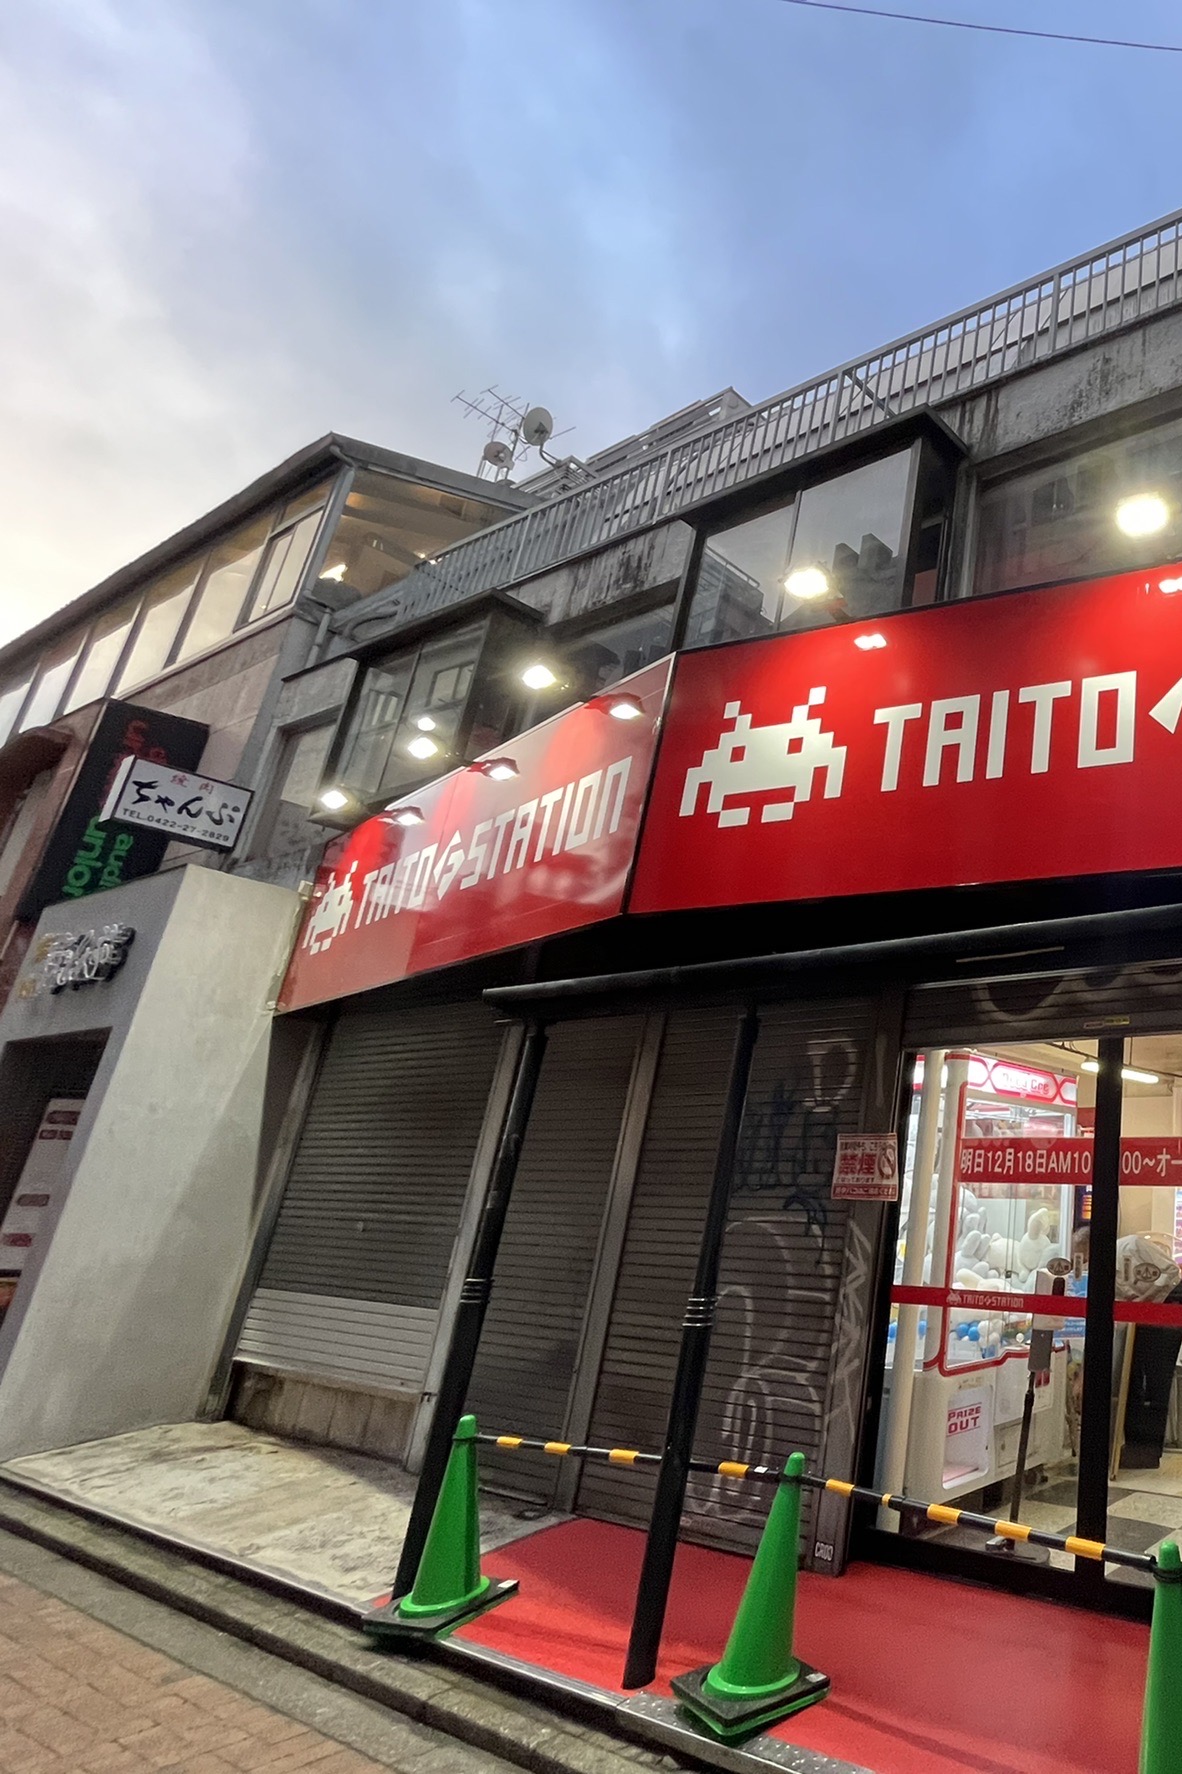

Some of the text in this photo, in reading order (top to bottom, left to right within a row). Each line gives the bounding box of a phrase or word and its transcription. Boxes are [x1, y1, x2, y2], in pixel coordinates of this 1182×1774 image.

[873, 670, 1138, 793] TAITO
[354, 842, 439, 930] TAITO
[460, 755, 634, 891] STATION
[838, 1152, 877, 1177] 禁煙
[947, 1405, 982, 1422] PRIZE
[948, 1415, 980, 1435] OUT
